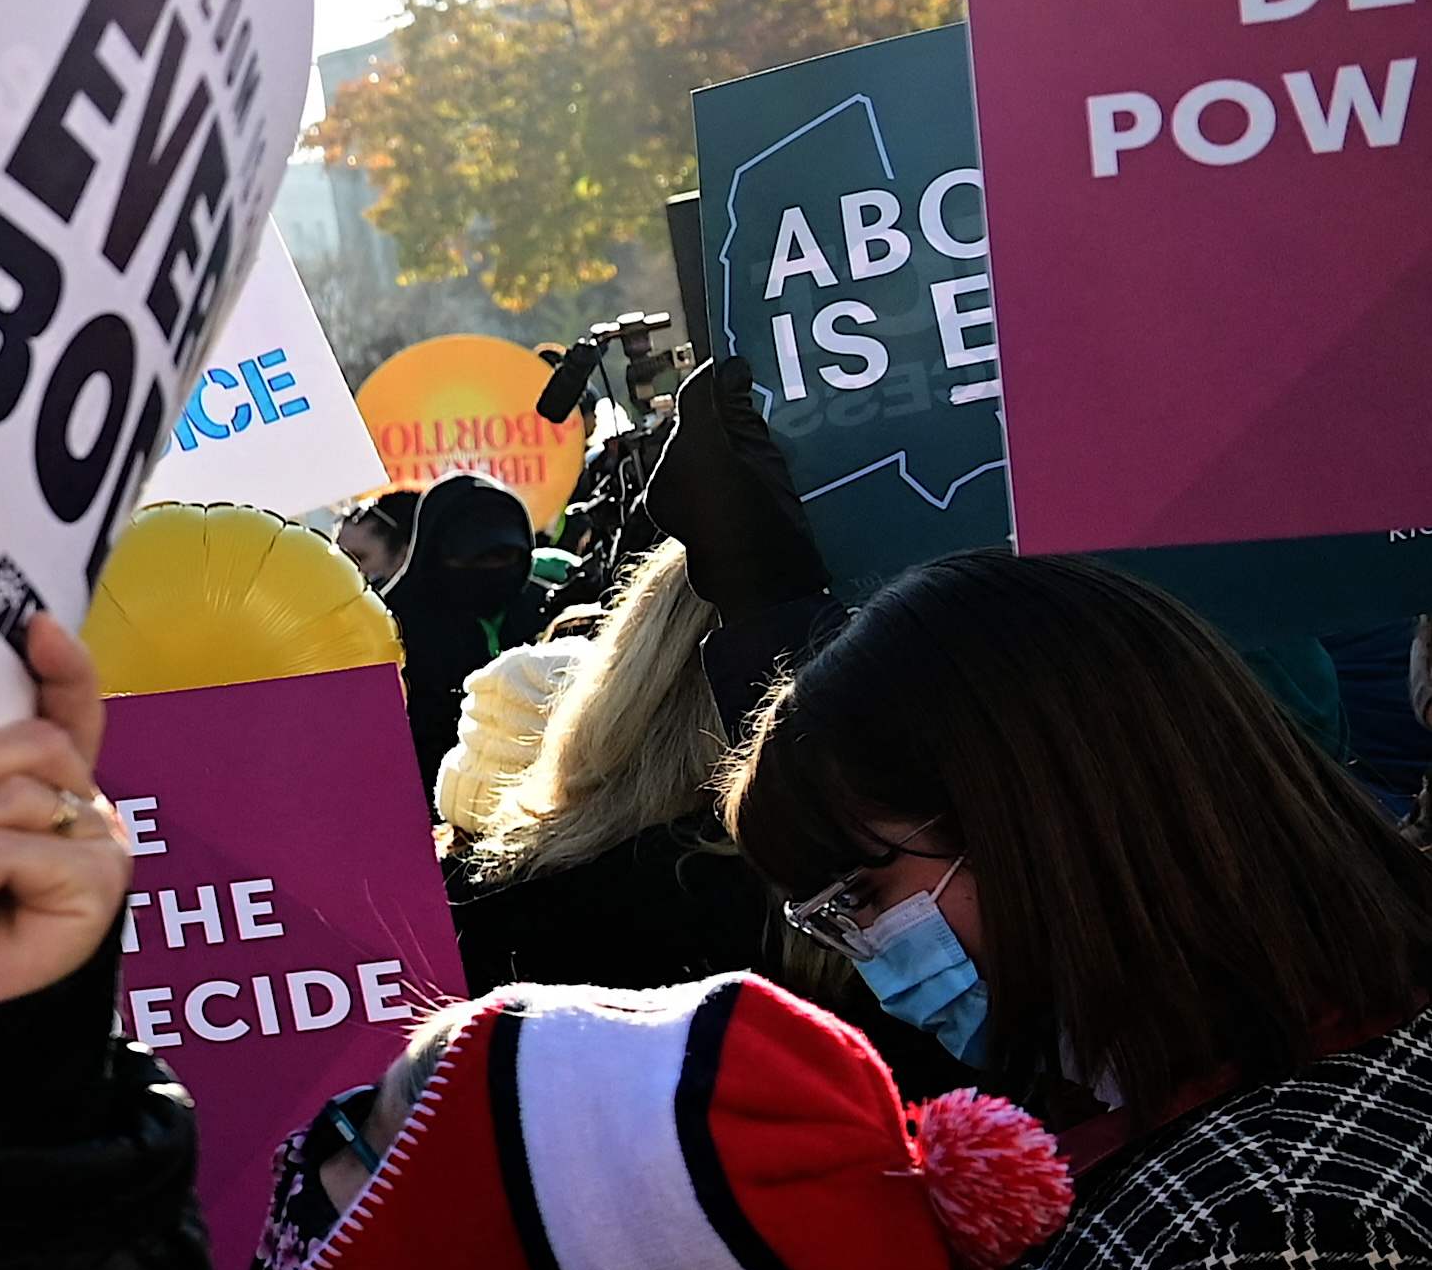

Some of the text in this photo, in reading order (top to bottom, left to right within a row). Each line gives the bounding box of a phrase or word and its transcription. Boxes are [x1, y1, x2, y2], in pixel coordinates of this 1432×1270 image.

[1086, 58, 1417, 179] POW
[772, 300, 889, 401] IS
[120, 877, 284, 955] THE
[128, 959, 413, 1049] ECIDE
